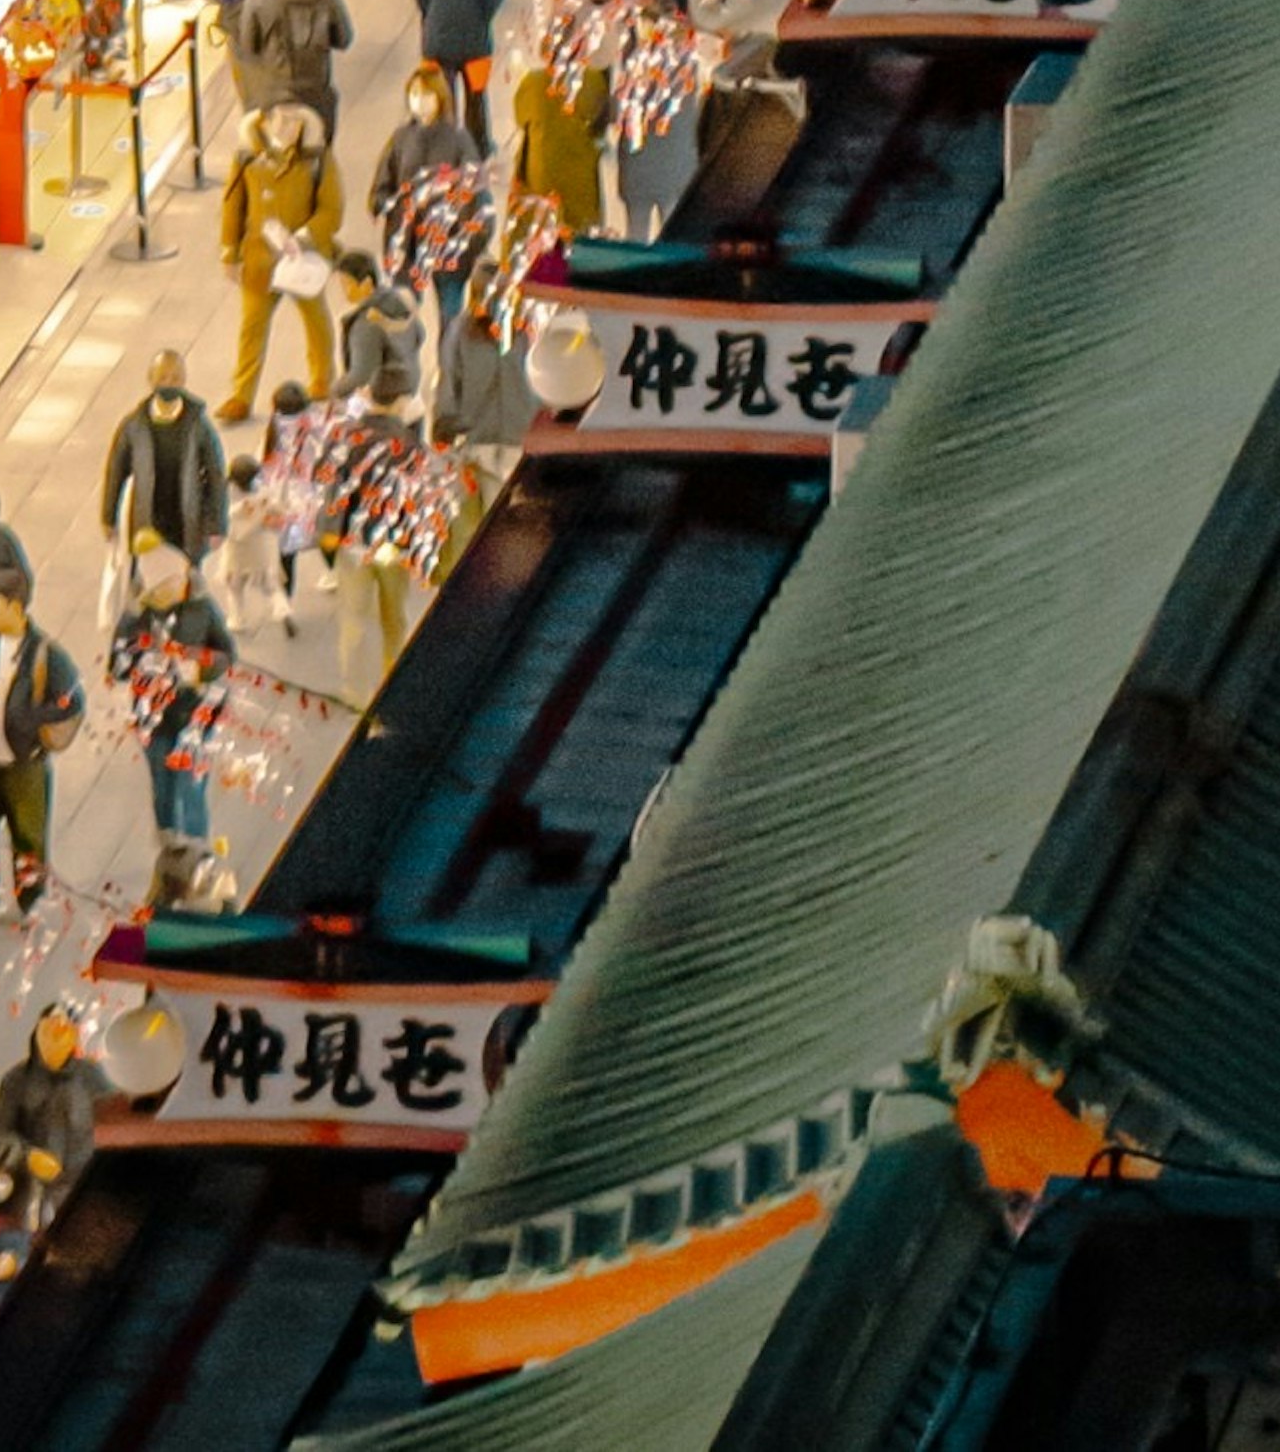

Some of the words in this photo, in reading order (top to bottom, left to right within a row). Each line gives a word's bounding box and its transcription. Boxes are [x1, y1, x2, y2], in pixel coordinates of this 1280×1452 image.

[619, 324, 859, 421] 仲見世
[200, 1004, 468, 1114] 仲見世
